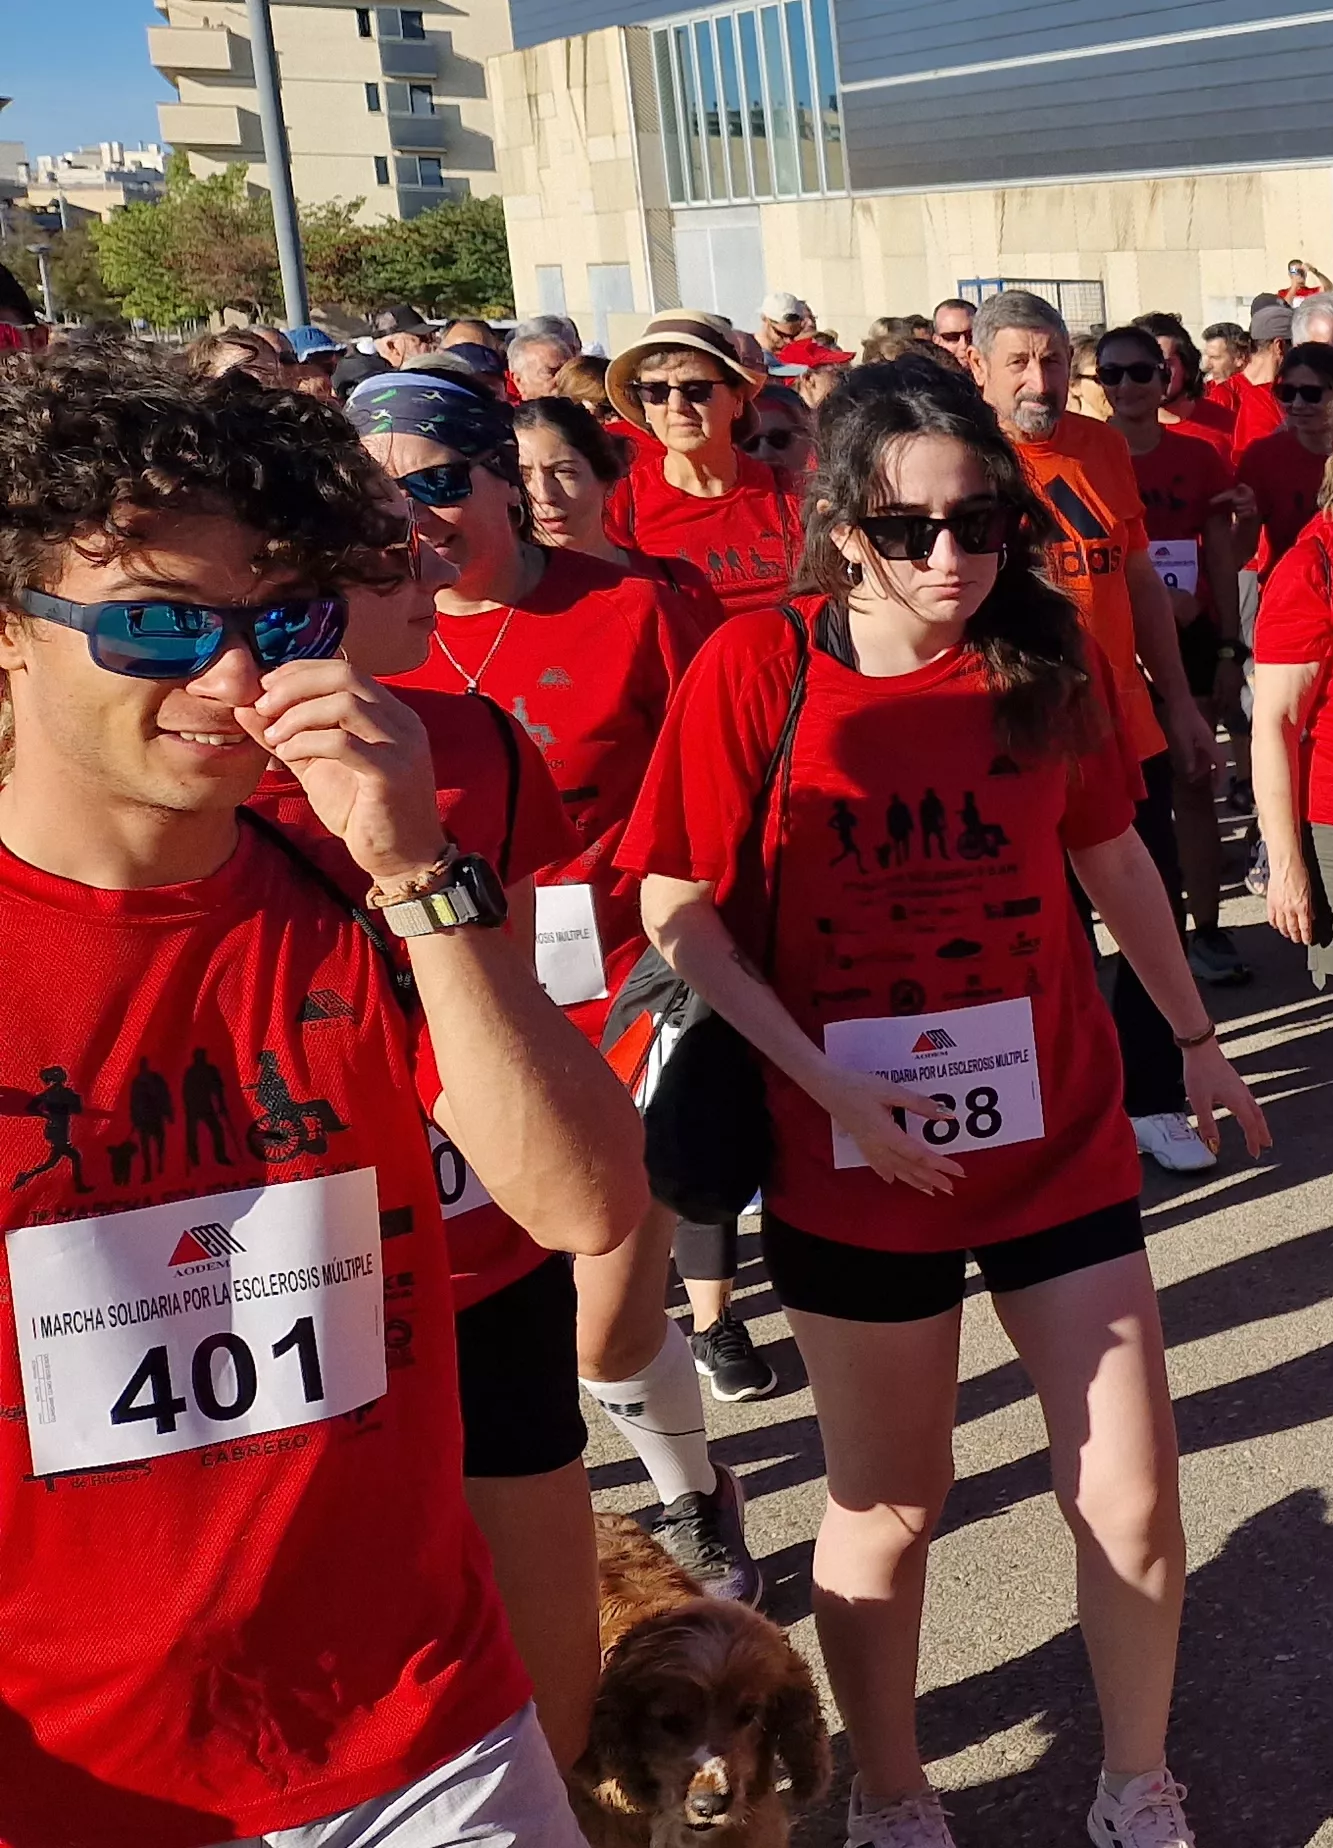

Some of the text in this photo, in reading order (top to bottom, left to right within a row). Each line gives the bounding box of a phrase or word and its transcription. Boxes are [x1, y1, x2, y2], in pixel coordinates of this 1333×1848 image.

[919, 1065, 936, 1081] POR
[937, 1064, 948, 1078] LA
[949, 1056, 995, 1075] ESCLEROSIS
[891, 1086, 1003, 1145] 88
[173, 1258, 231, 1278] AODEM
[32, 1317, 38, 1340] I
[41, 1307, 105, 1339] MARCHA
[108, 1293, 182, 1327] SOLIDARIA
[183, 1288, 212, 1314] POR
[213, 1282, 232, 1306] LA
[233, 1268, 320, 1303] ESCLEROSIS
[322, 1253, 374, 1287] MÚLTIPLE
[110, 1315, 325, 1435] 401
[201, 1434, 309, 1469] CABRERO
